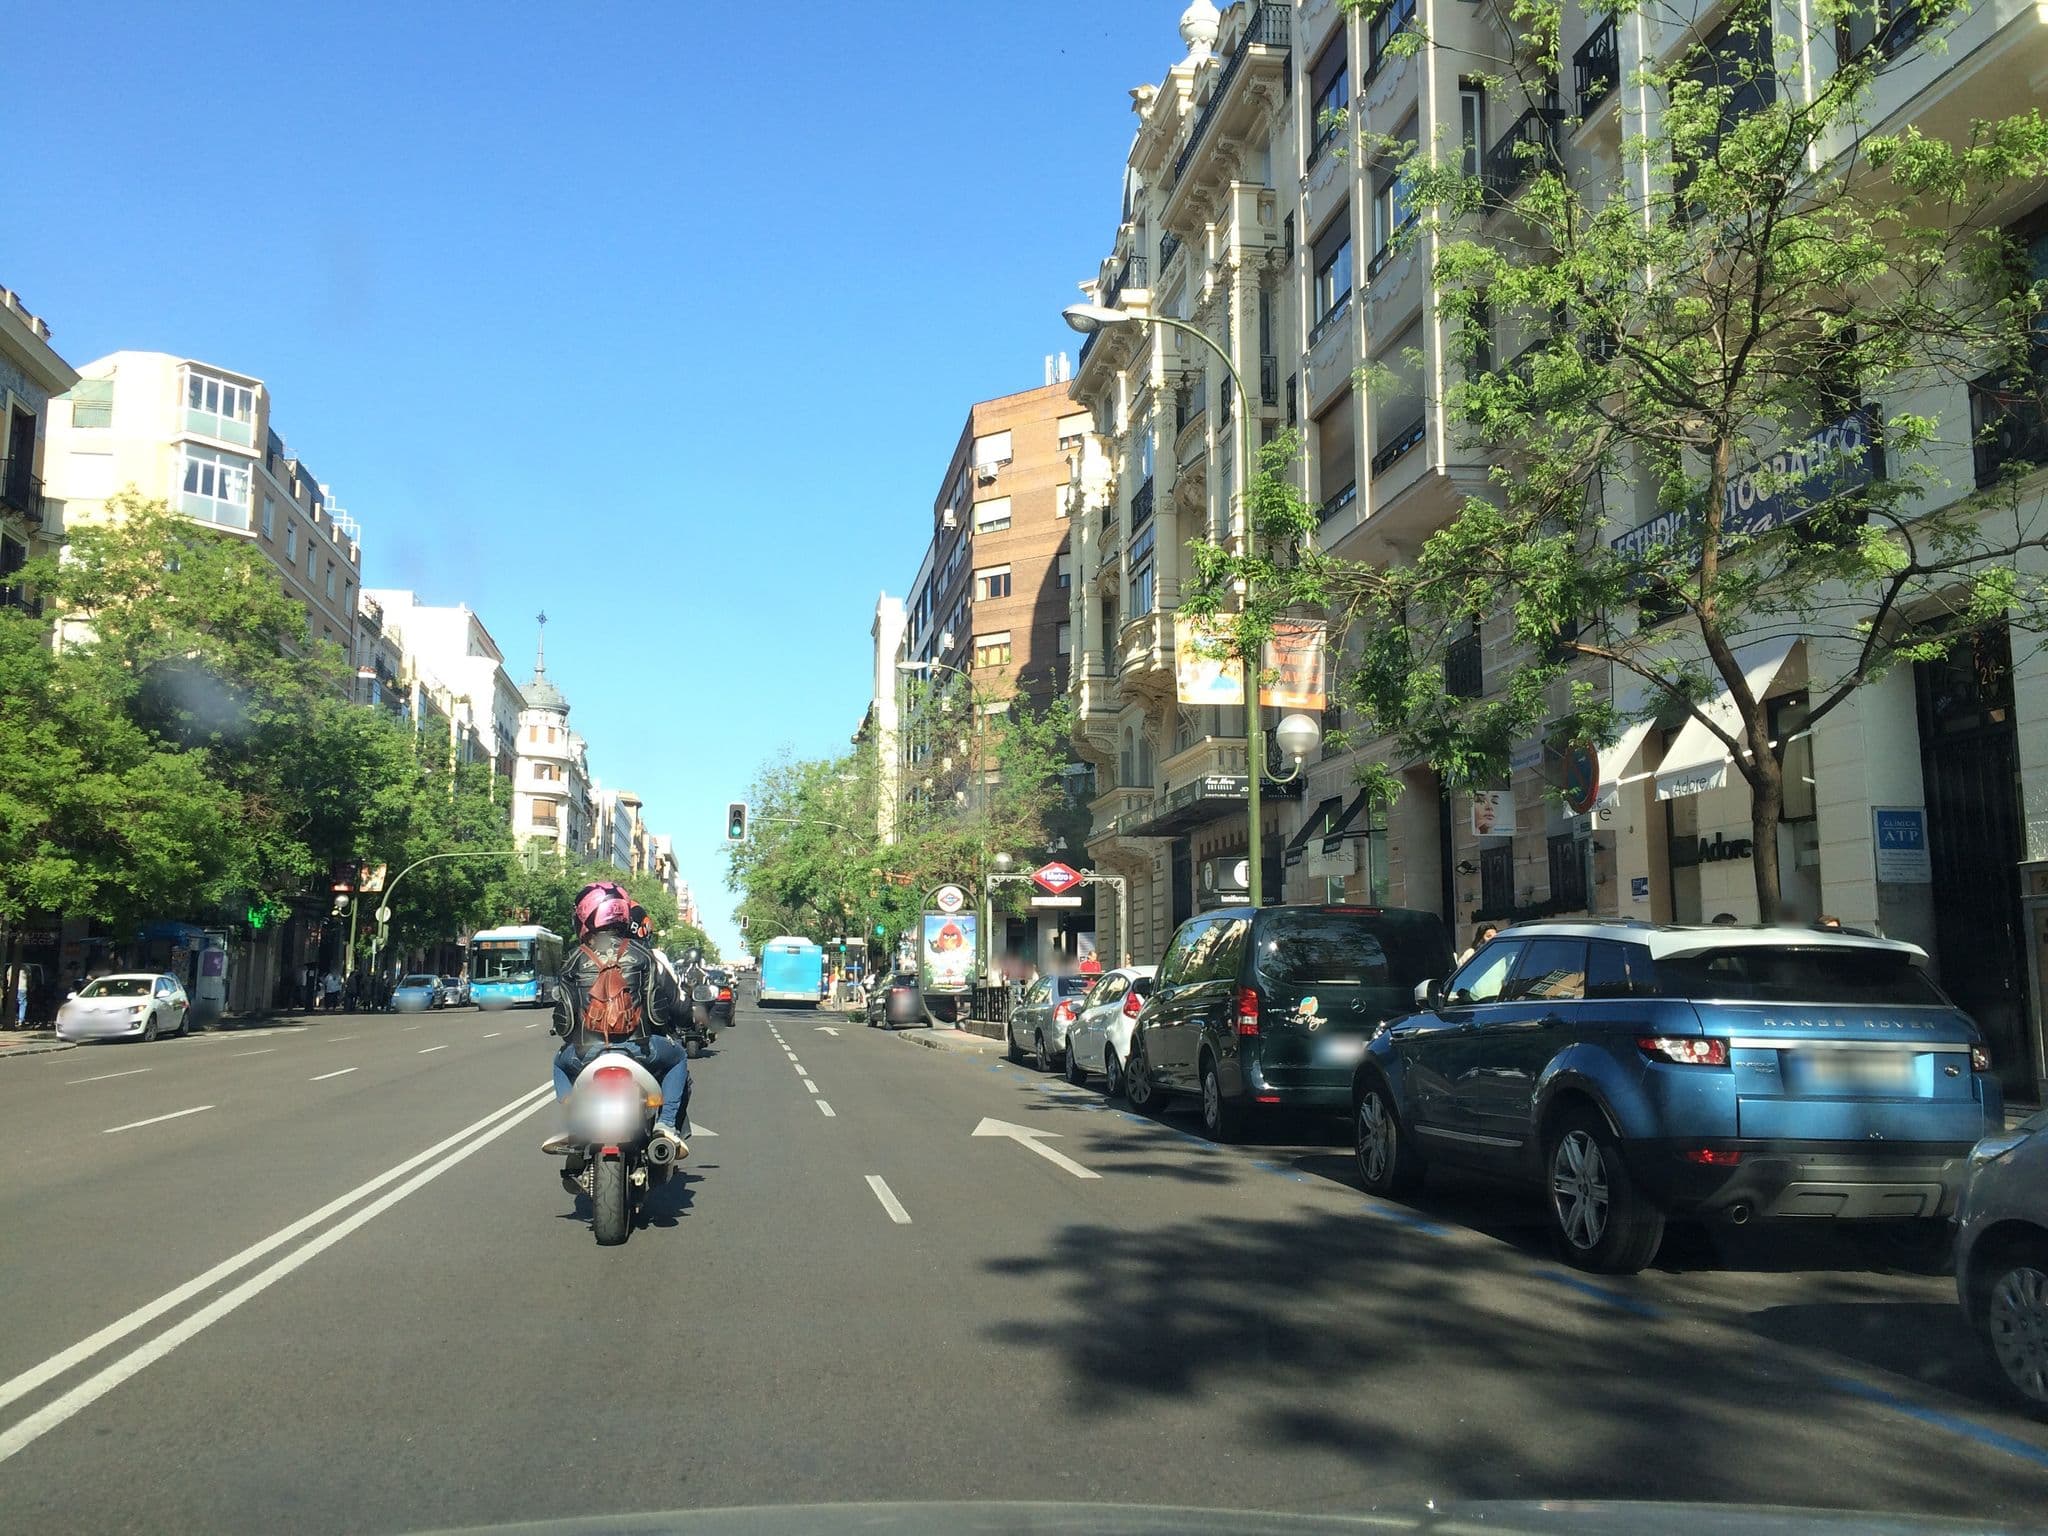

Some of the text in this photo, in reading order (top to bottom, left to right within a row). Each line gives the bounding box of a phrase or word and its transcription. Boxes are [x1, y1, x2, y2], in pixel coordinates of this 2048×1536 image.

[1673, 774, 1707, 793] Adore
[1885, 829, 1919, 842] ATP
[1697, 831, 1753, 863] Adore
[1046, 872, 1069, 881] Metro
[1763, 1018, 1936, 1031] RANGE ROVER
